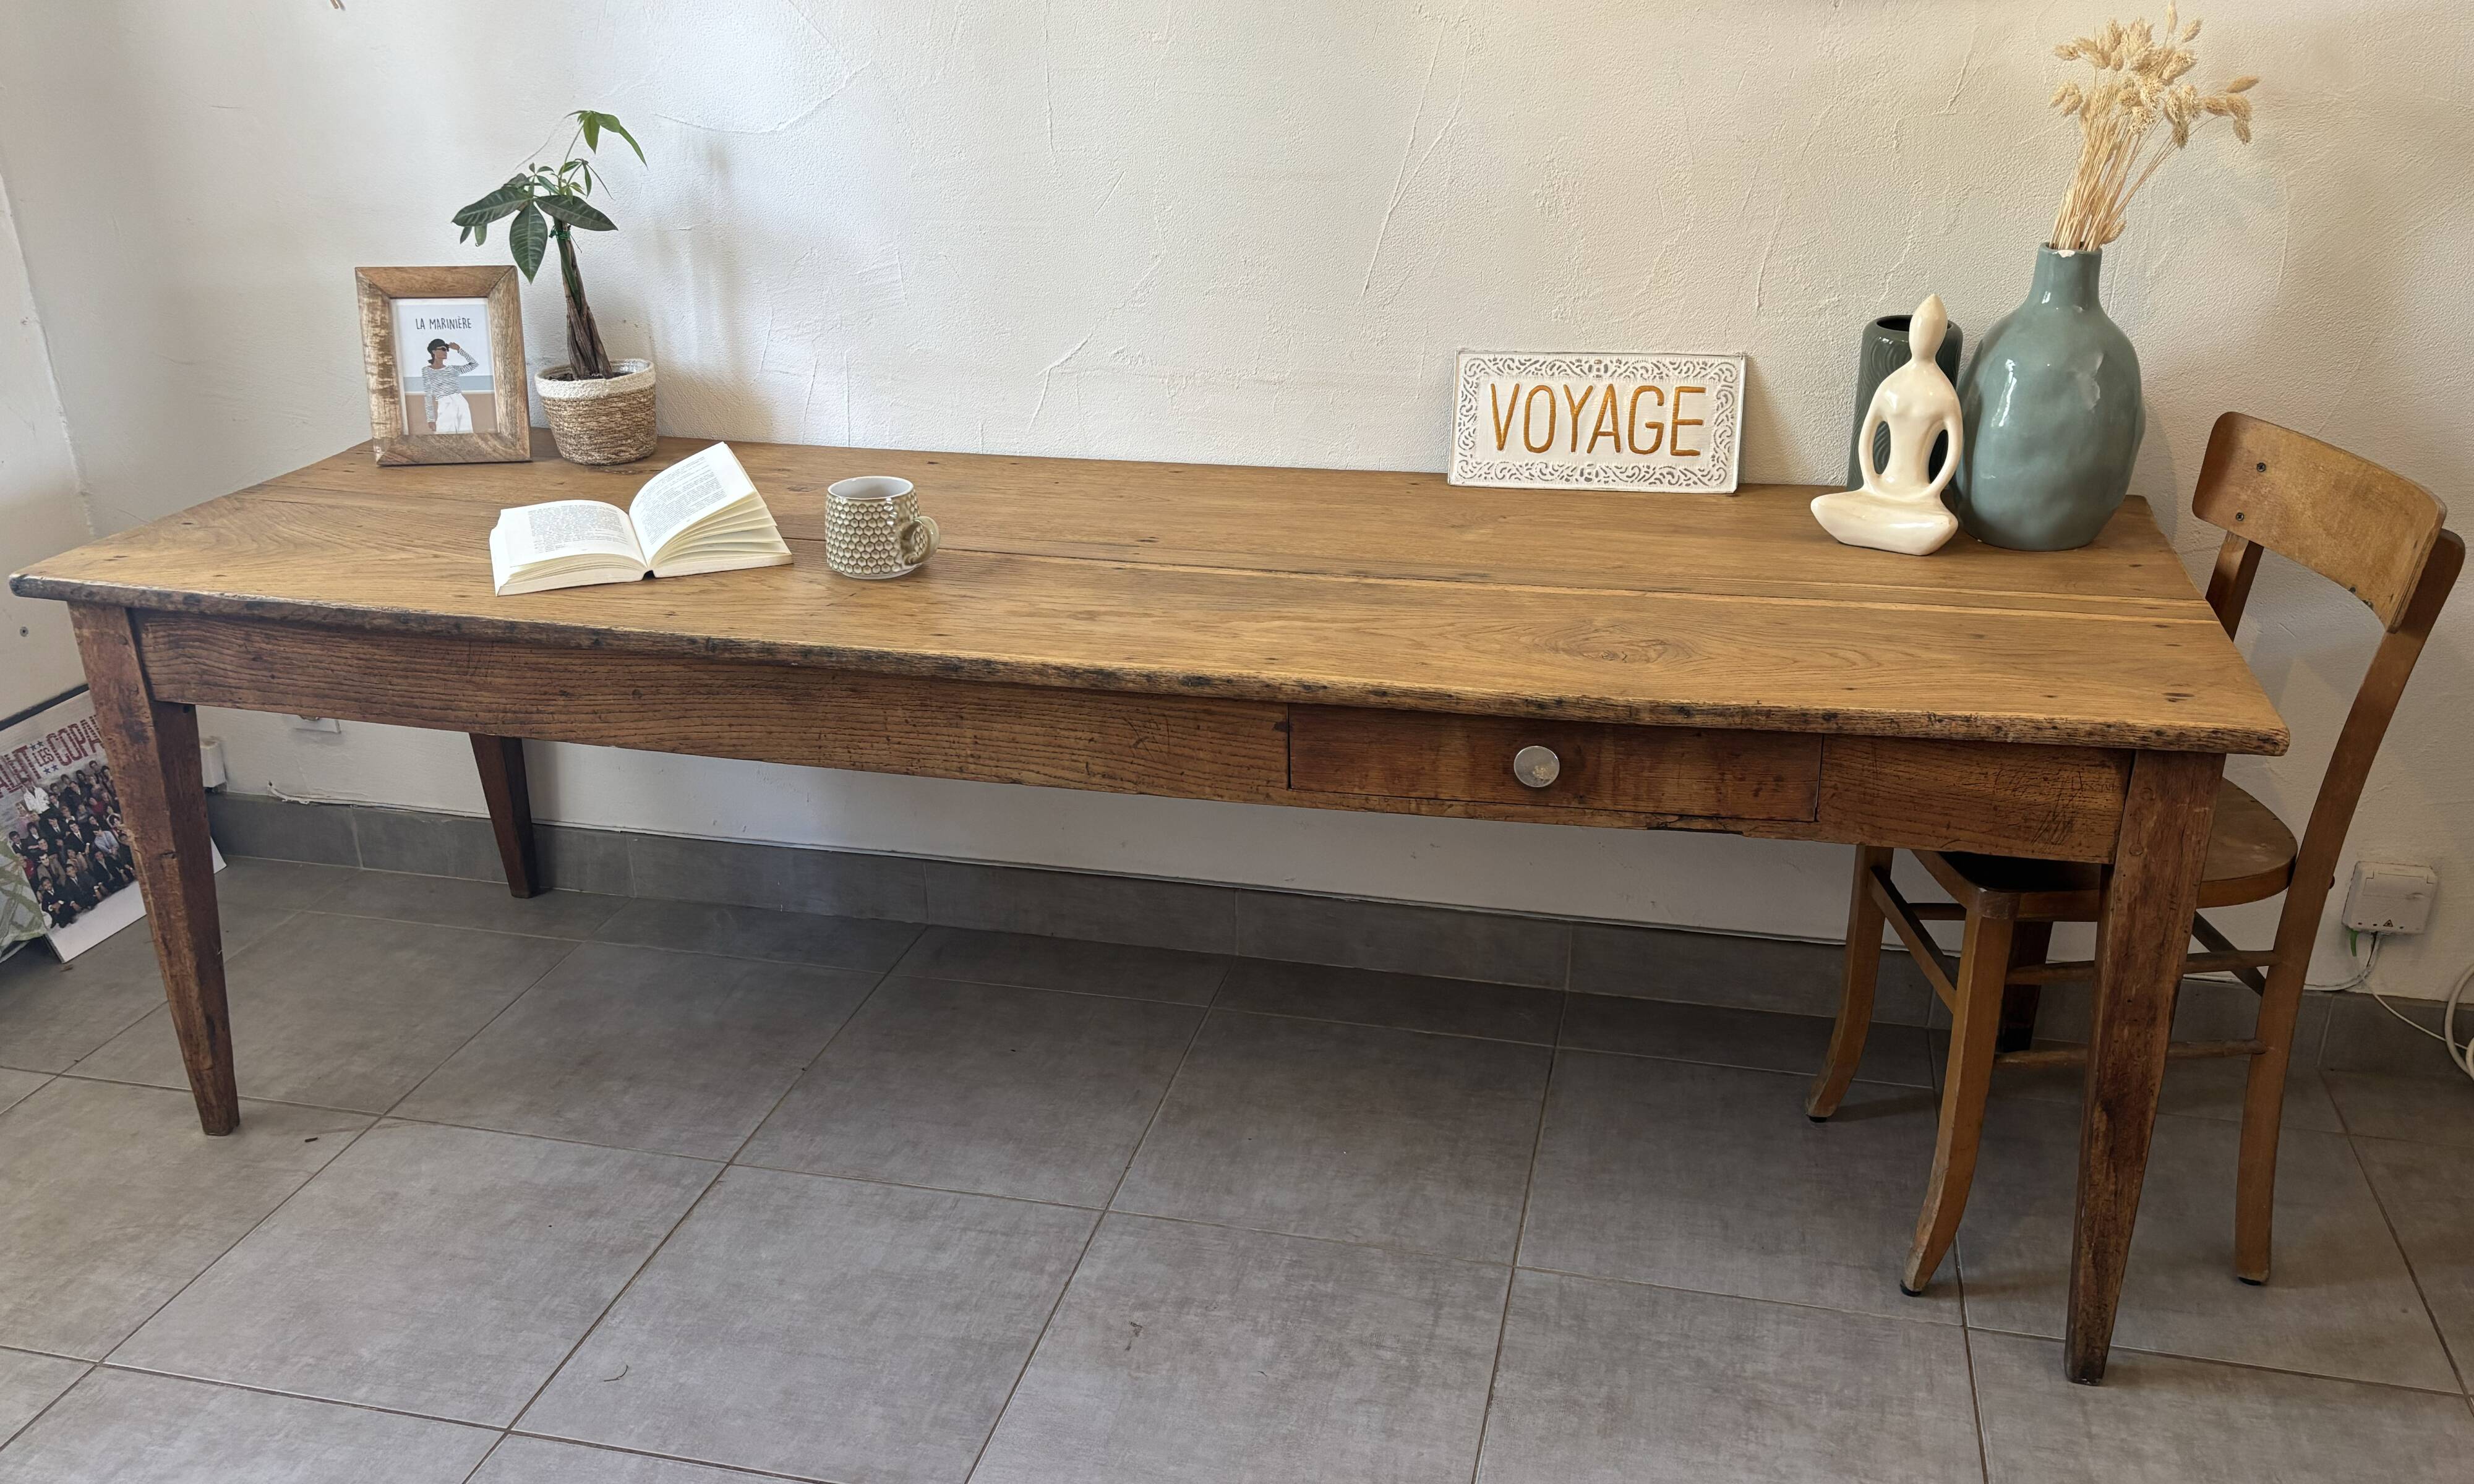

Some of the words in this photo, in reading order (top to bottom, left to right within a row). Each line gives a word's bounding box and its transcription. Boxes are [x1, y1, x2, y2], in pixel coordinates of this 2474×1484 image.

[416, 318, 426, 330] LA
[429, 316, 472, 330] MARINIÈRE
[1490, 383, 1706, 456] VOYAGE
[32, 747, 54, 767] LES
